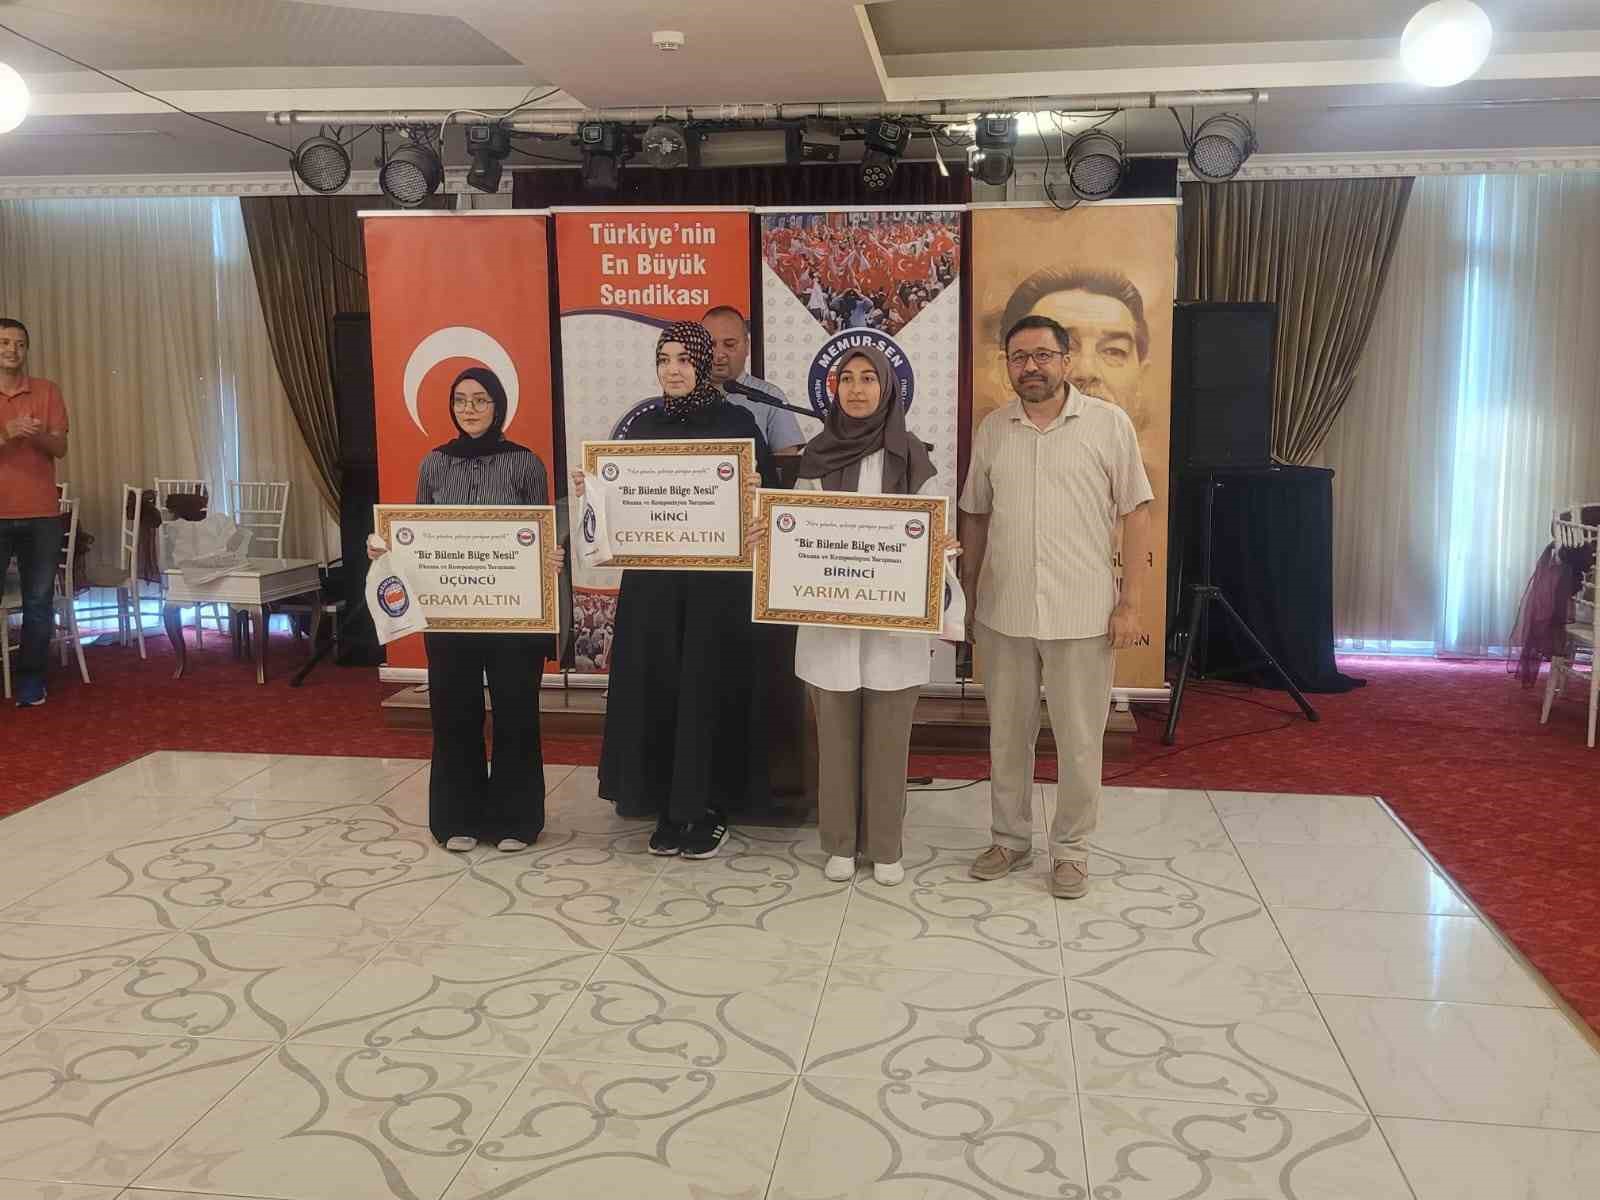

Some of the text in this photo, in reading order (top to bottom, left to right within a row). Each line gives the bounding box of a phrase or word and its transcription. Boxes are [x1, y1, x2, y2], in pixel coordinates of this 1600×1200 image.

[589, 223, 716, 248] Türkiye'nin
[602, 253, 707, 279] En Büyük
[600, 284, 709, 305] Sendikası
[818, 336, 903, 368] MEMUR-SEN
[670, 485, 691, 498] Bilge
[650, 511, 688, 521] İKİNCİ
[615, 531, 725, 546] ÇEYREK ALTIN
[816, 539, 849, 551] Bilenle
[851, 541, 875, 553] Bilge
[467, 550, 490, 562] Bilge
[823, 566, 875, 579] BİRİNCİ
[439, 575, 496, 587] ÜÇÜNCÜ
[417, 593, 521, 606] GRAM ALTIN
[792, 585, 906, 603] YARIM ALTIN
